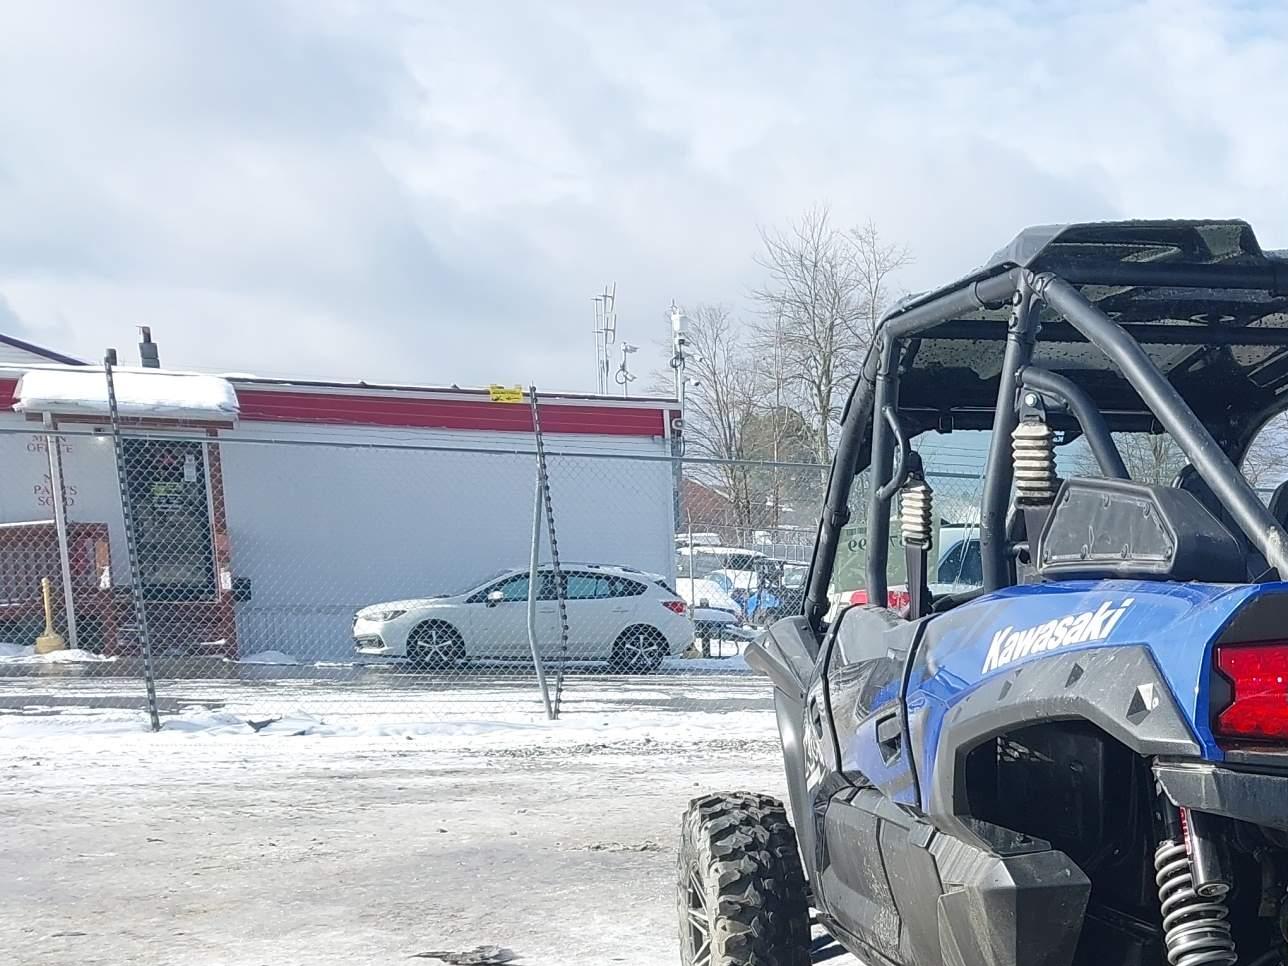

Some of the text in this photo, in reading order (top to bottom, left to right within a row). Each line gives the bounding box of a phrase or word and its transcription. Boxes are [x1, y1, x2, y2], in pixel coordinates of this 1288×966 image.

[34, 485, 77, 495] PAS
[38, 497, 74, 506] SOD
[981, 598, 1136, 674] Kawasaki
